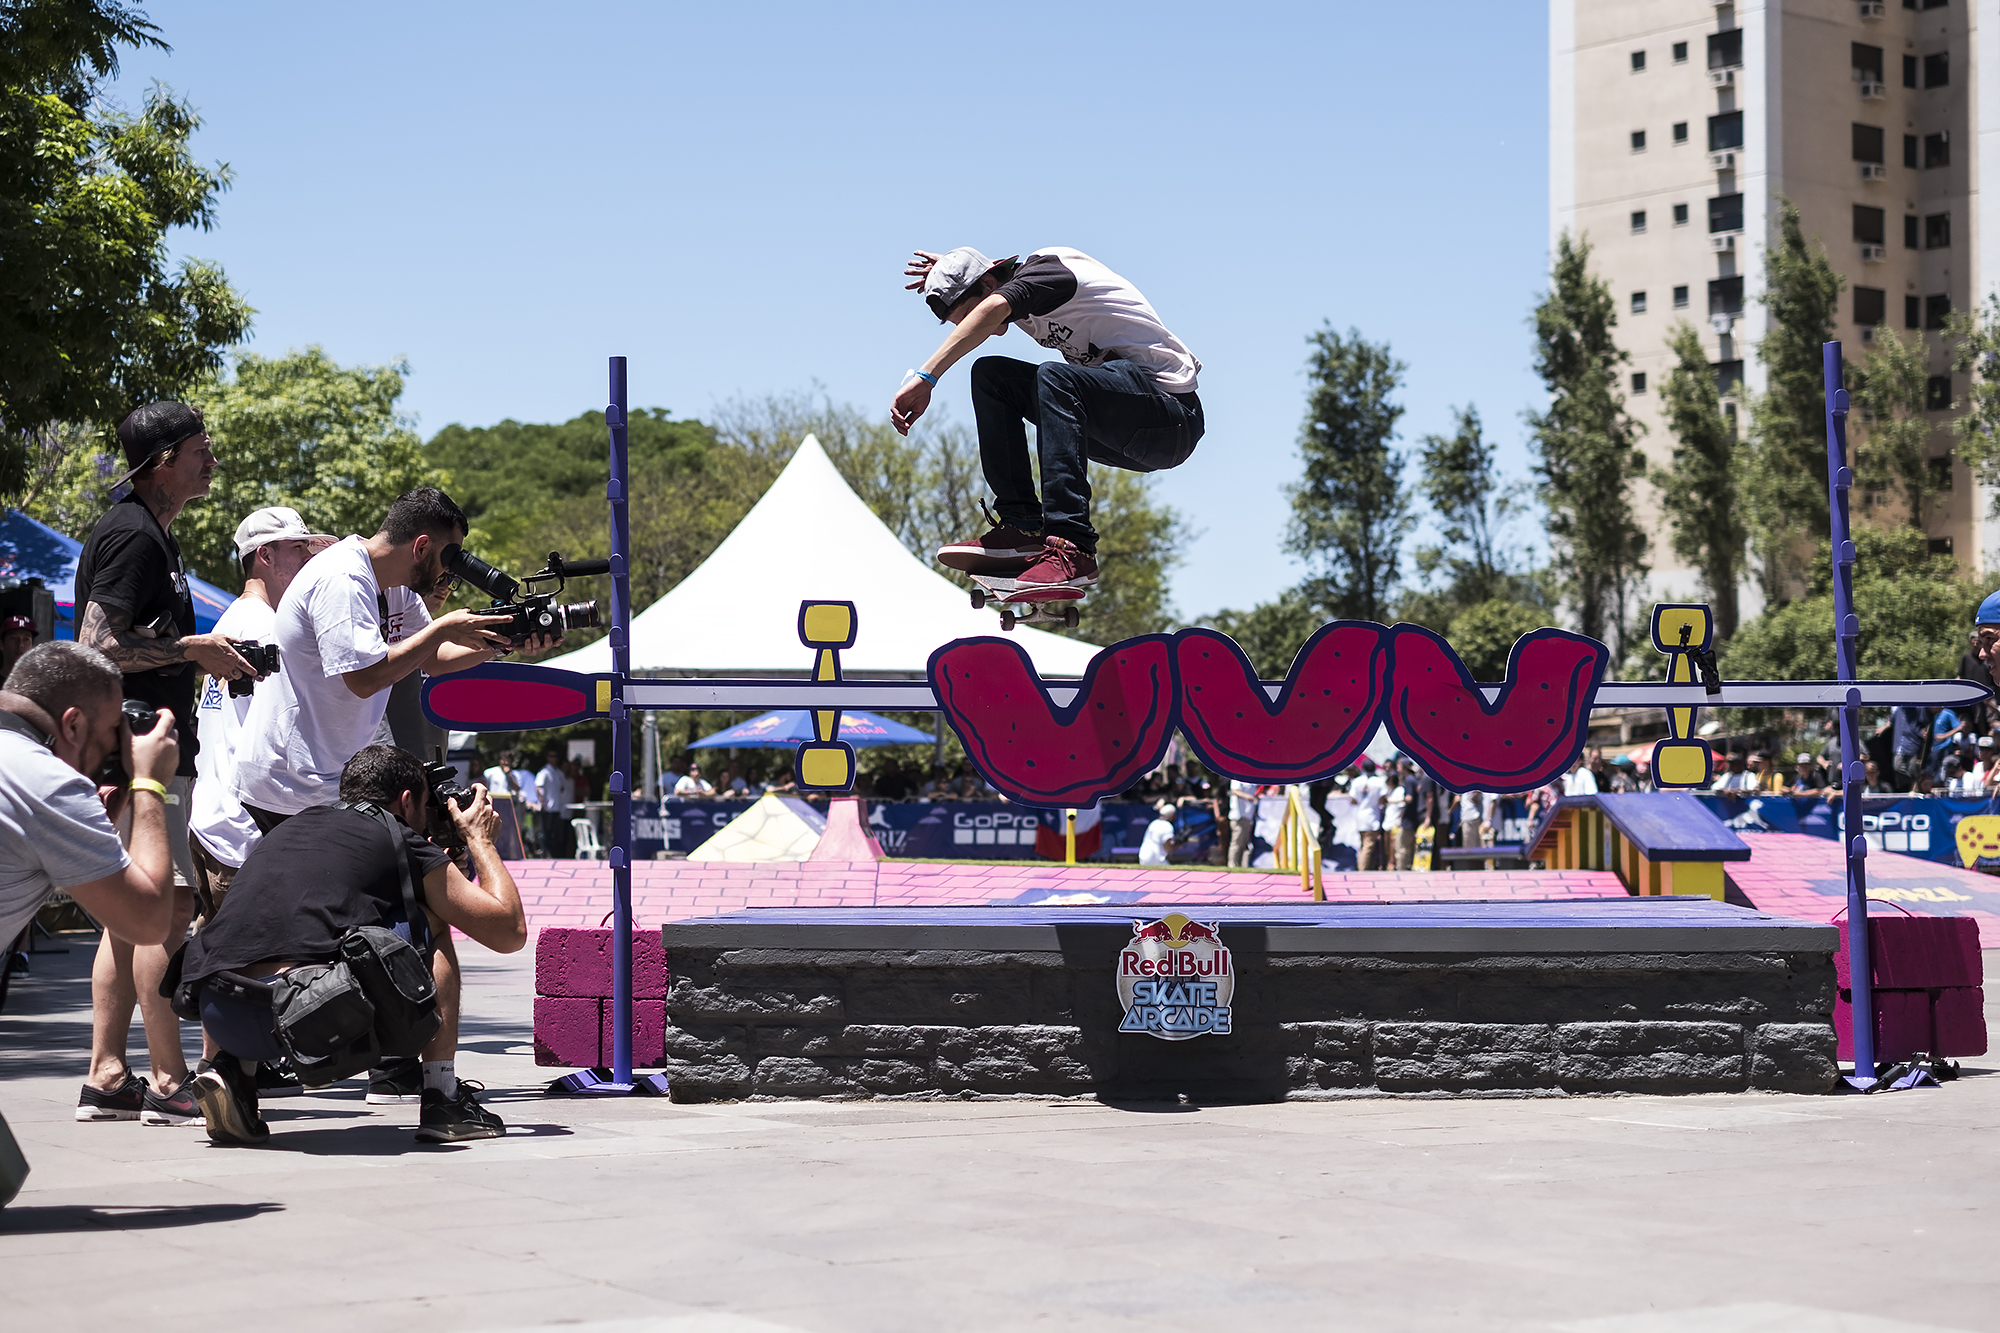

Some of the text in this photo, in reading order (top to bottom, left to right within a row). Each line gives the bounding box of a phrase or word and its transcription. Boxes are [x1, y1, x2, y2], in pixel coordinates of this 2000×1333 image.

[954, 812, 1039, 829] GoPro
[1122, 949, 1228, 976] Red Bull
[1133, 981, 1217, 1007] SKATE
[1119, 1005, 1231, 1033] ARCADE
